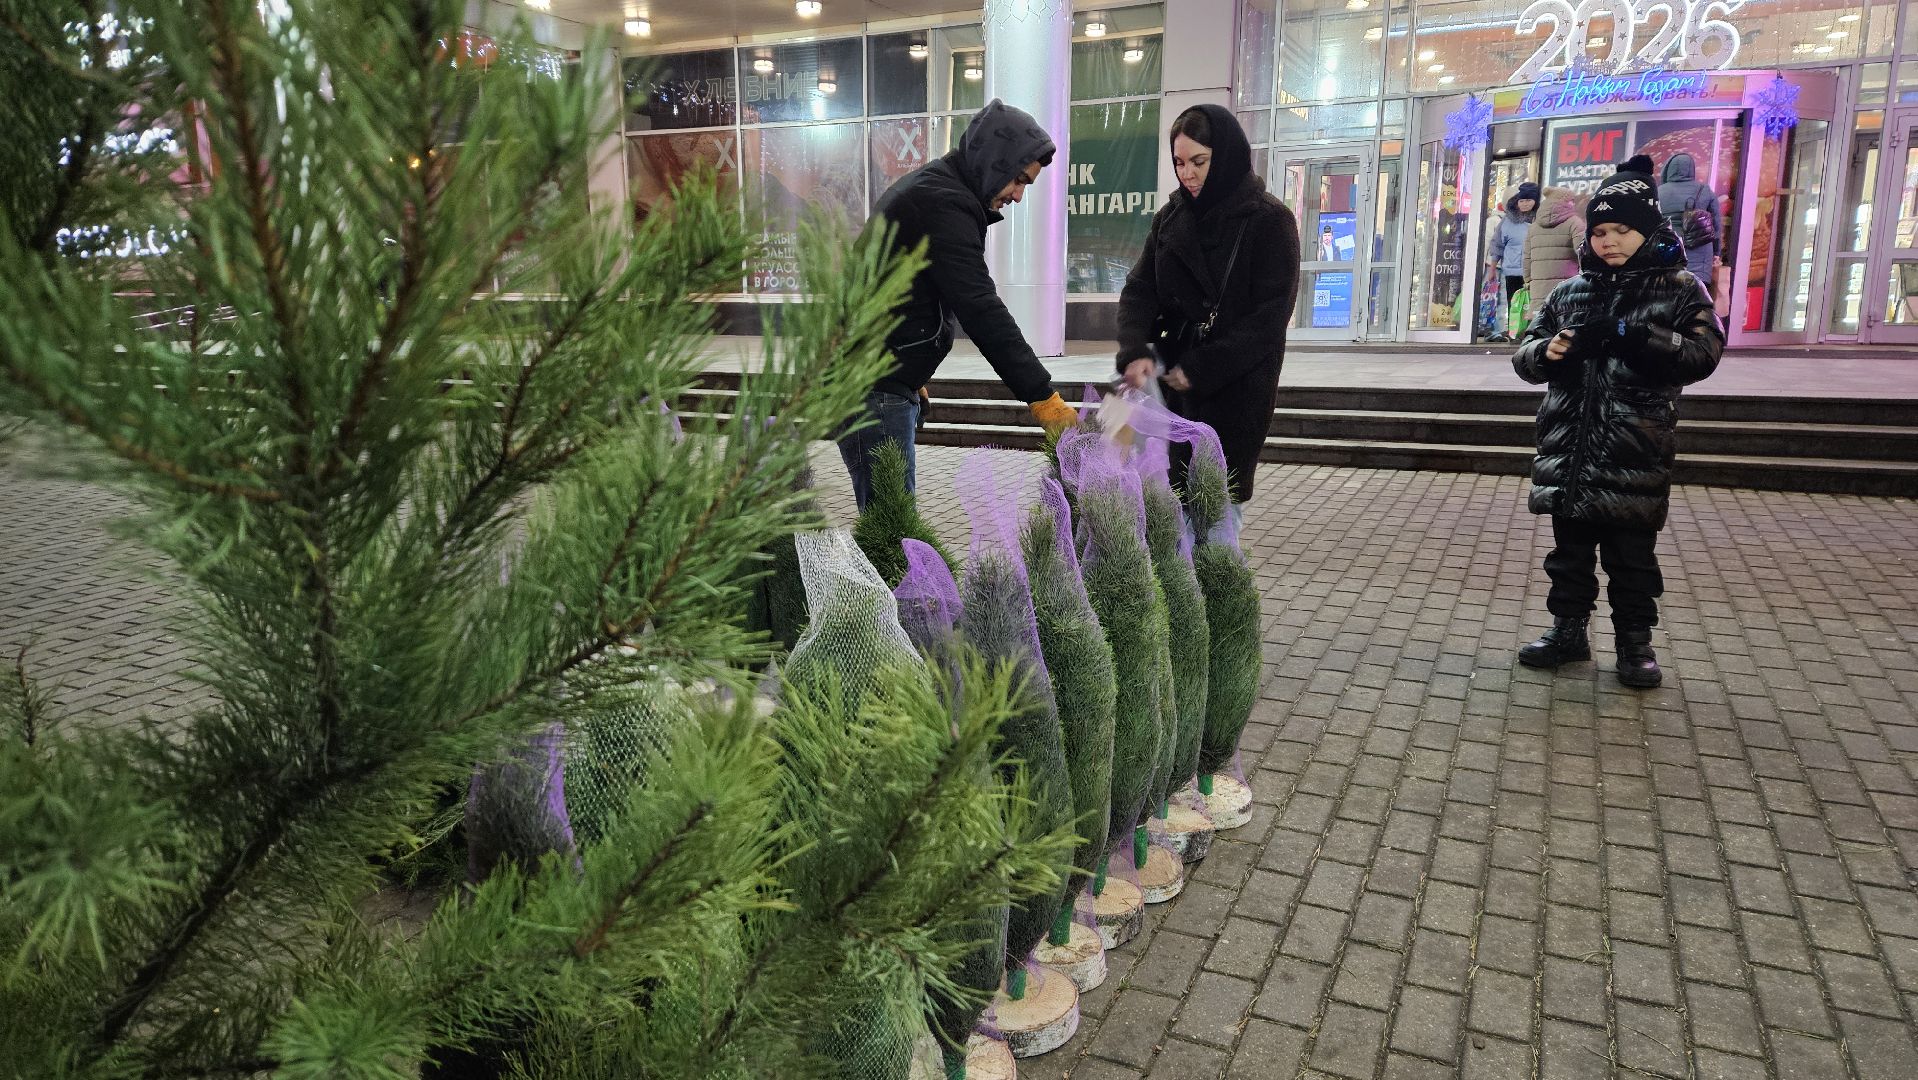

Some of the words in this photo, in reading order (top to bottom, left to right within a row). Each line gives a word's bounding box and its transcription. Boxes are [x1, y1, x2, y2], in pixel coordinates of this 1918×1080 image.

[1507, 0, 1746, 84] 2026
[1558, 129, 1624, 164] БИГ
[1557, 163, 1617, 179] МАЭСТРО
[753, 261, 802, 275] КРУАСС
